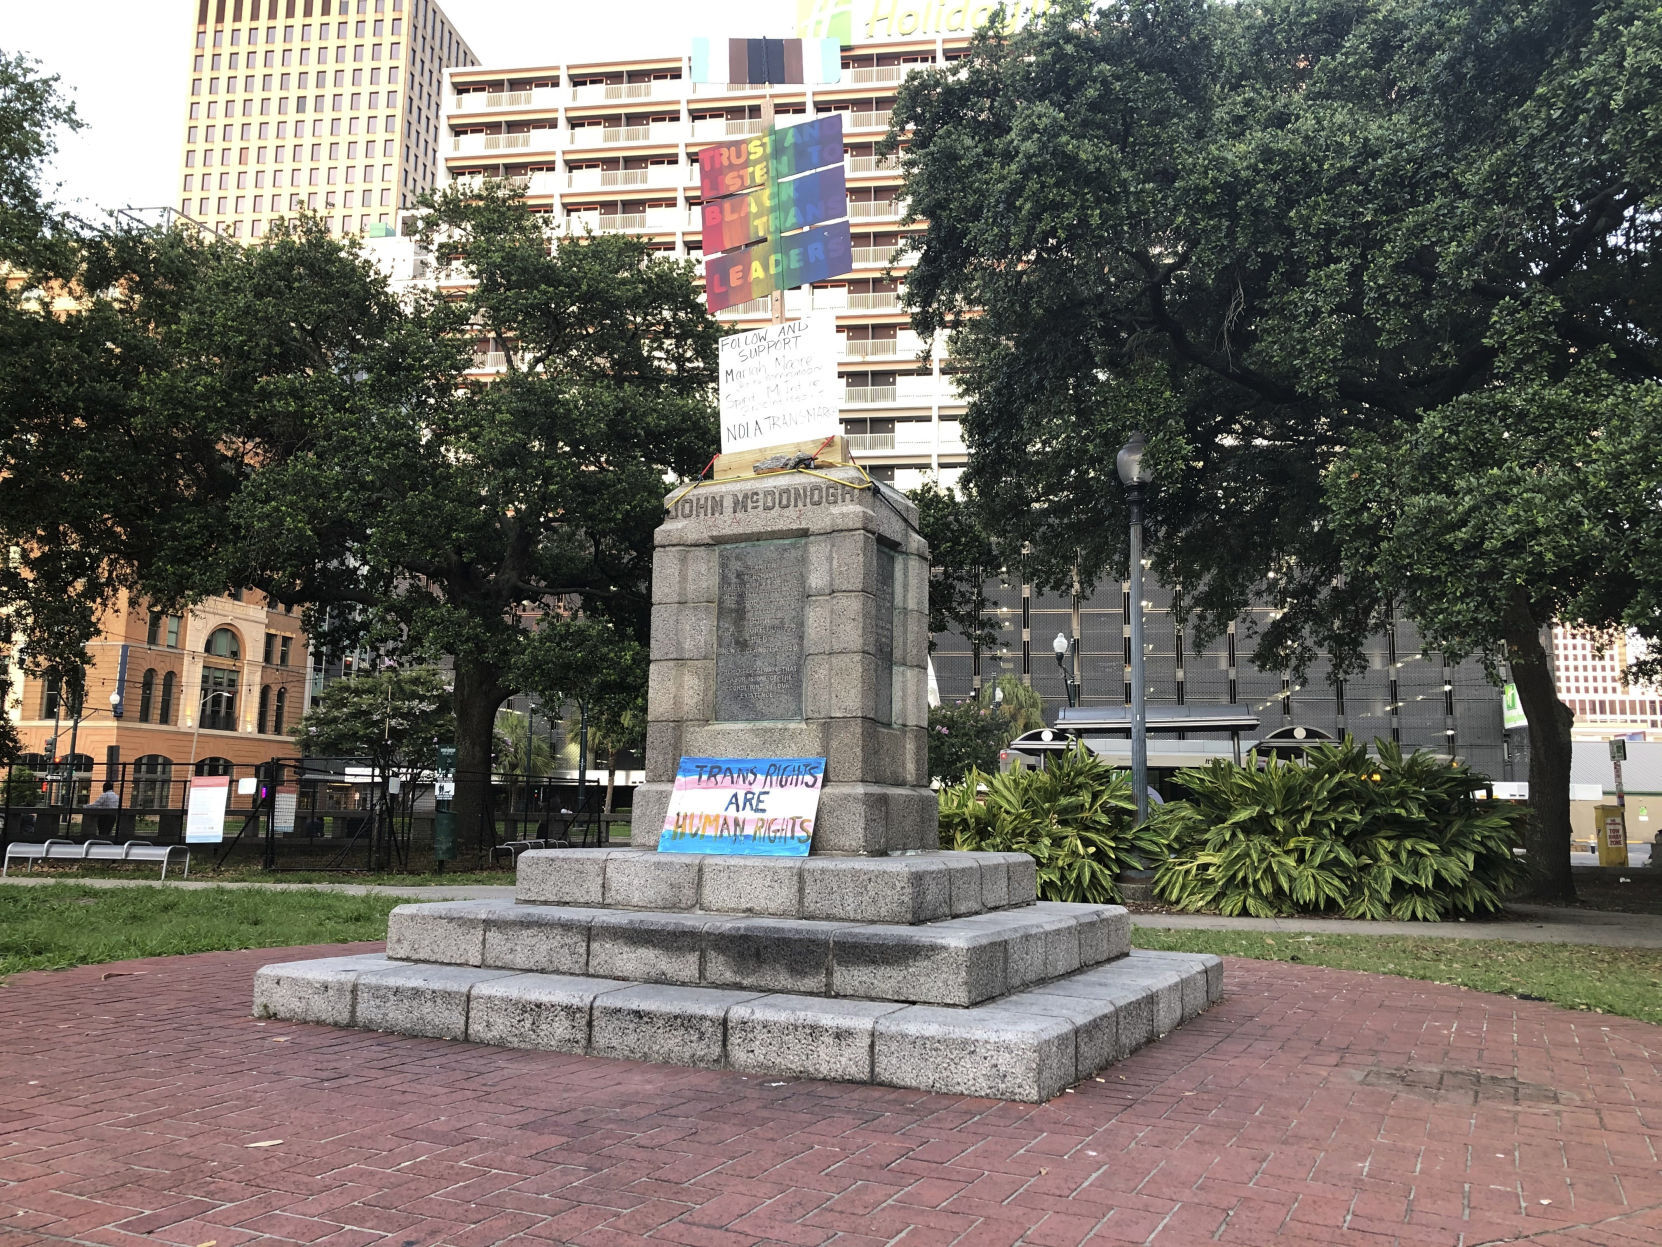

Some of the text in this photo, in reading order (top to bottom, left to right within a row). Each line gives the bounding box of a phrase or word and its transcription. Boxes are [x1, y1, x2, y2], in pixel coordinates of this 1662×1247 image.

[865, 0, 1022, 39] Holiday
[700, 117, 841, 172] TRUST AND
[703, 143, 840, 197] LISTEN TO
[704, 181, 800, 227] BLACK
[753, 199, 844, 237] TRANS
[713, 239, 844, 294] LEADERS
[721, 321, 809, 352] FOLLOW AND
[738, 335, 802, 363] SUPPORT
[666, 494, 724, 520] JOHN
[695, 763, 819, 789] TRANS RIGHTS
[724, 791, 770, 813] ARE
[671, 811, 813, 845] HUMAN RIGHTS
